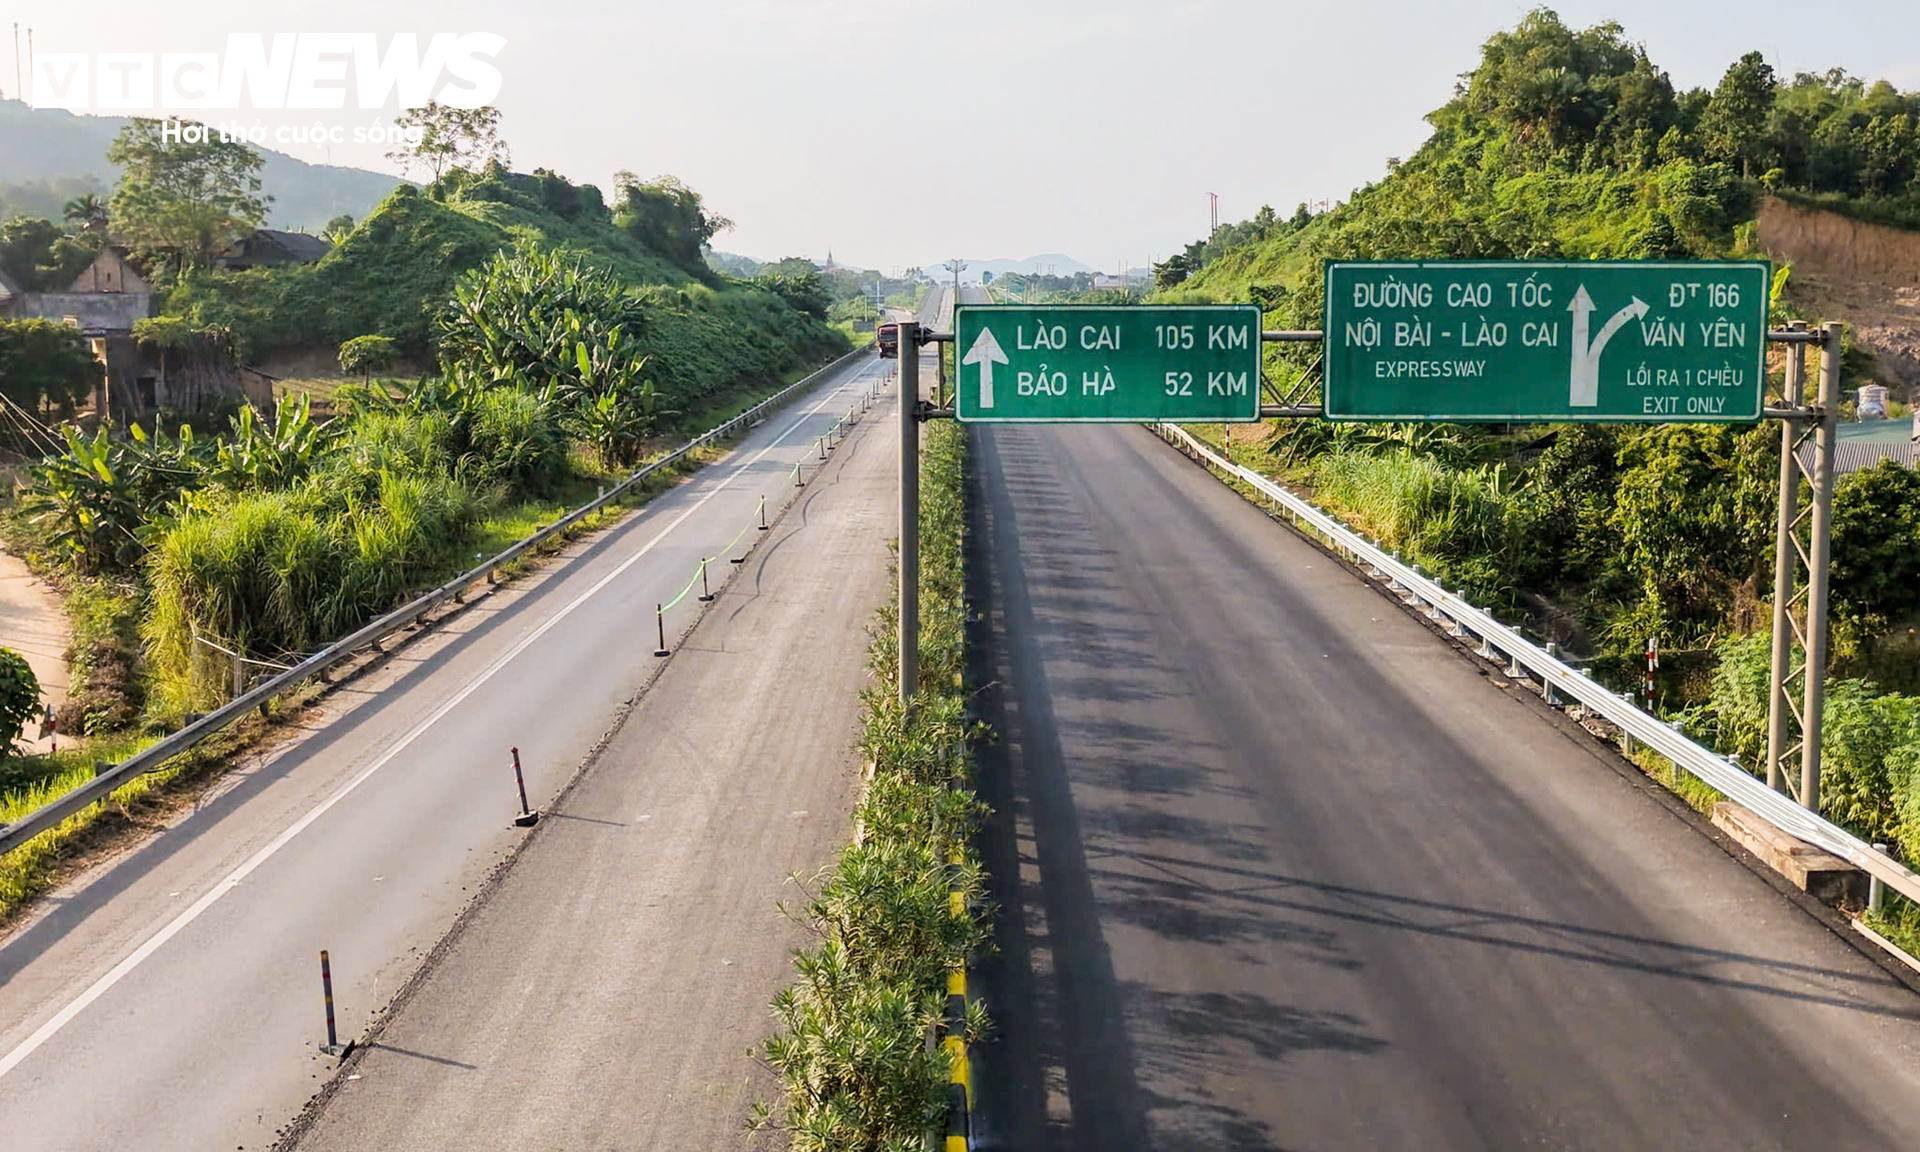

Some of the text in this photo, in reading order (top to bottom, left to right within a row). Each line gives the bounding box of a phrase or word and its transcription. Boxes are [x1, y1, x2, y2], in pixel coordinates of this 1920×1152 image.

[1353, 271, 1552, 308] ĐƯỜNG CAO TỐC
[1707, 283, 1740, 308] 166
[1017, 319, 1248, 350] LÀO CAI 105 KM
[1345, 316, 1381, 352] NỘI
[1394, 314, 1432, 347] BÀI
[1461, 315, 1507, 347] LÀO
[1522, 322, 1558, 347] CAI
[1641, 316, 1745, 347] VĂN YÊN
[1017, 363, 1247, 396] BẢO HÀ 52 KM
[1375, 360, 1486, 378] EXPRESSWAY
[1626, 361, 1651, 386] LỐI
[1656, 369, 1679, 386] RA
[1685, 369, 1690, 386] 1
[1643, 396, 1725, 413] EXIT ONLY
